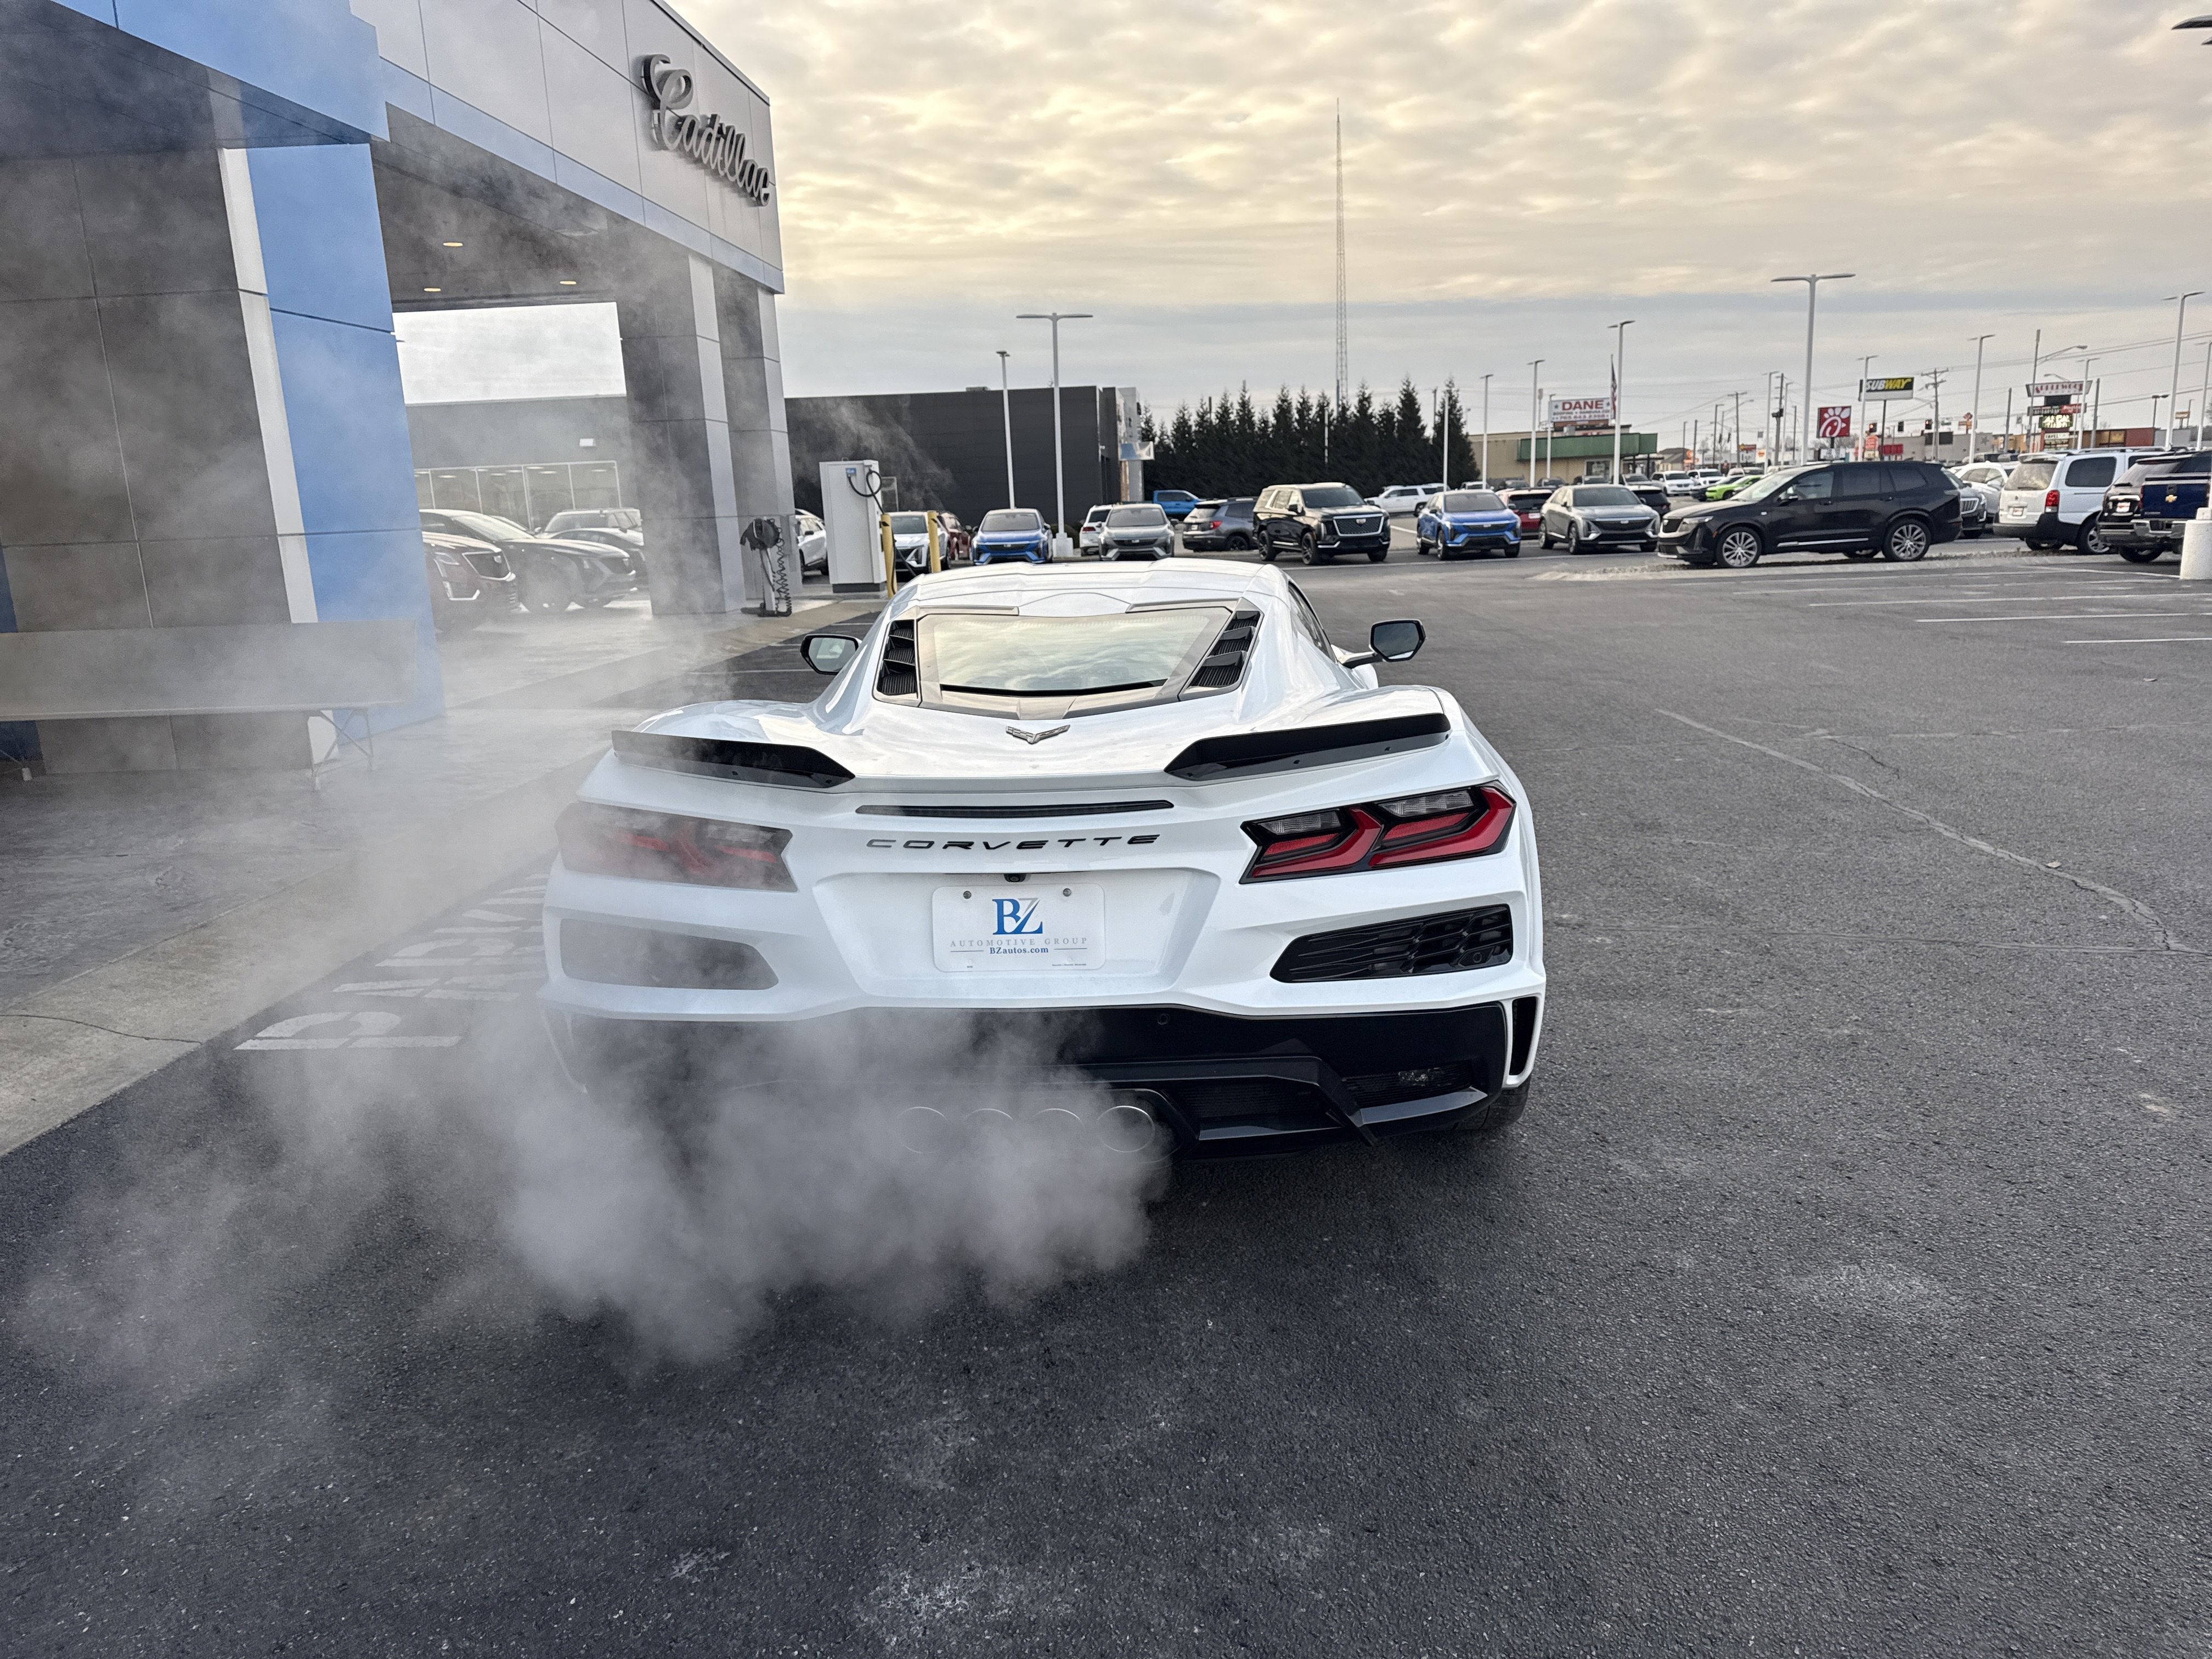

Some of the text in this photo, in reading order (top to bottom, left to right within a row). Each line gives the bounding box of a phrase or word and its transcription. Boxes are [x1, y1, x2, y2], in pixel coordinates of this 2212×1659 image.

[641, 54, 770, 206] Cadillac
[1866, 379, 1911, 390] SUBWAY
[1562, 400, 1604, 410] DANE
[866, 834, 1160, 850] CORVETTE
[992, 898, 1043, 935] BZ
[950, 938, 1035, 947] AUTOMOTIVE
